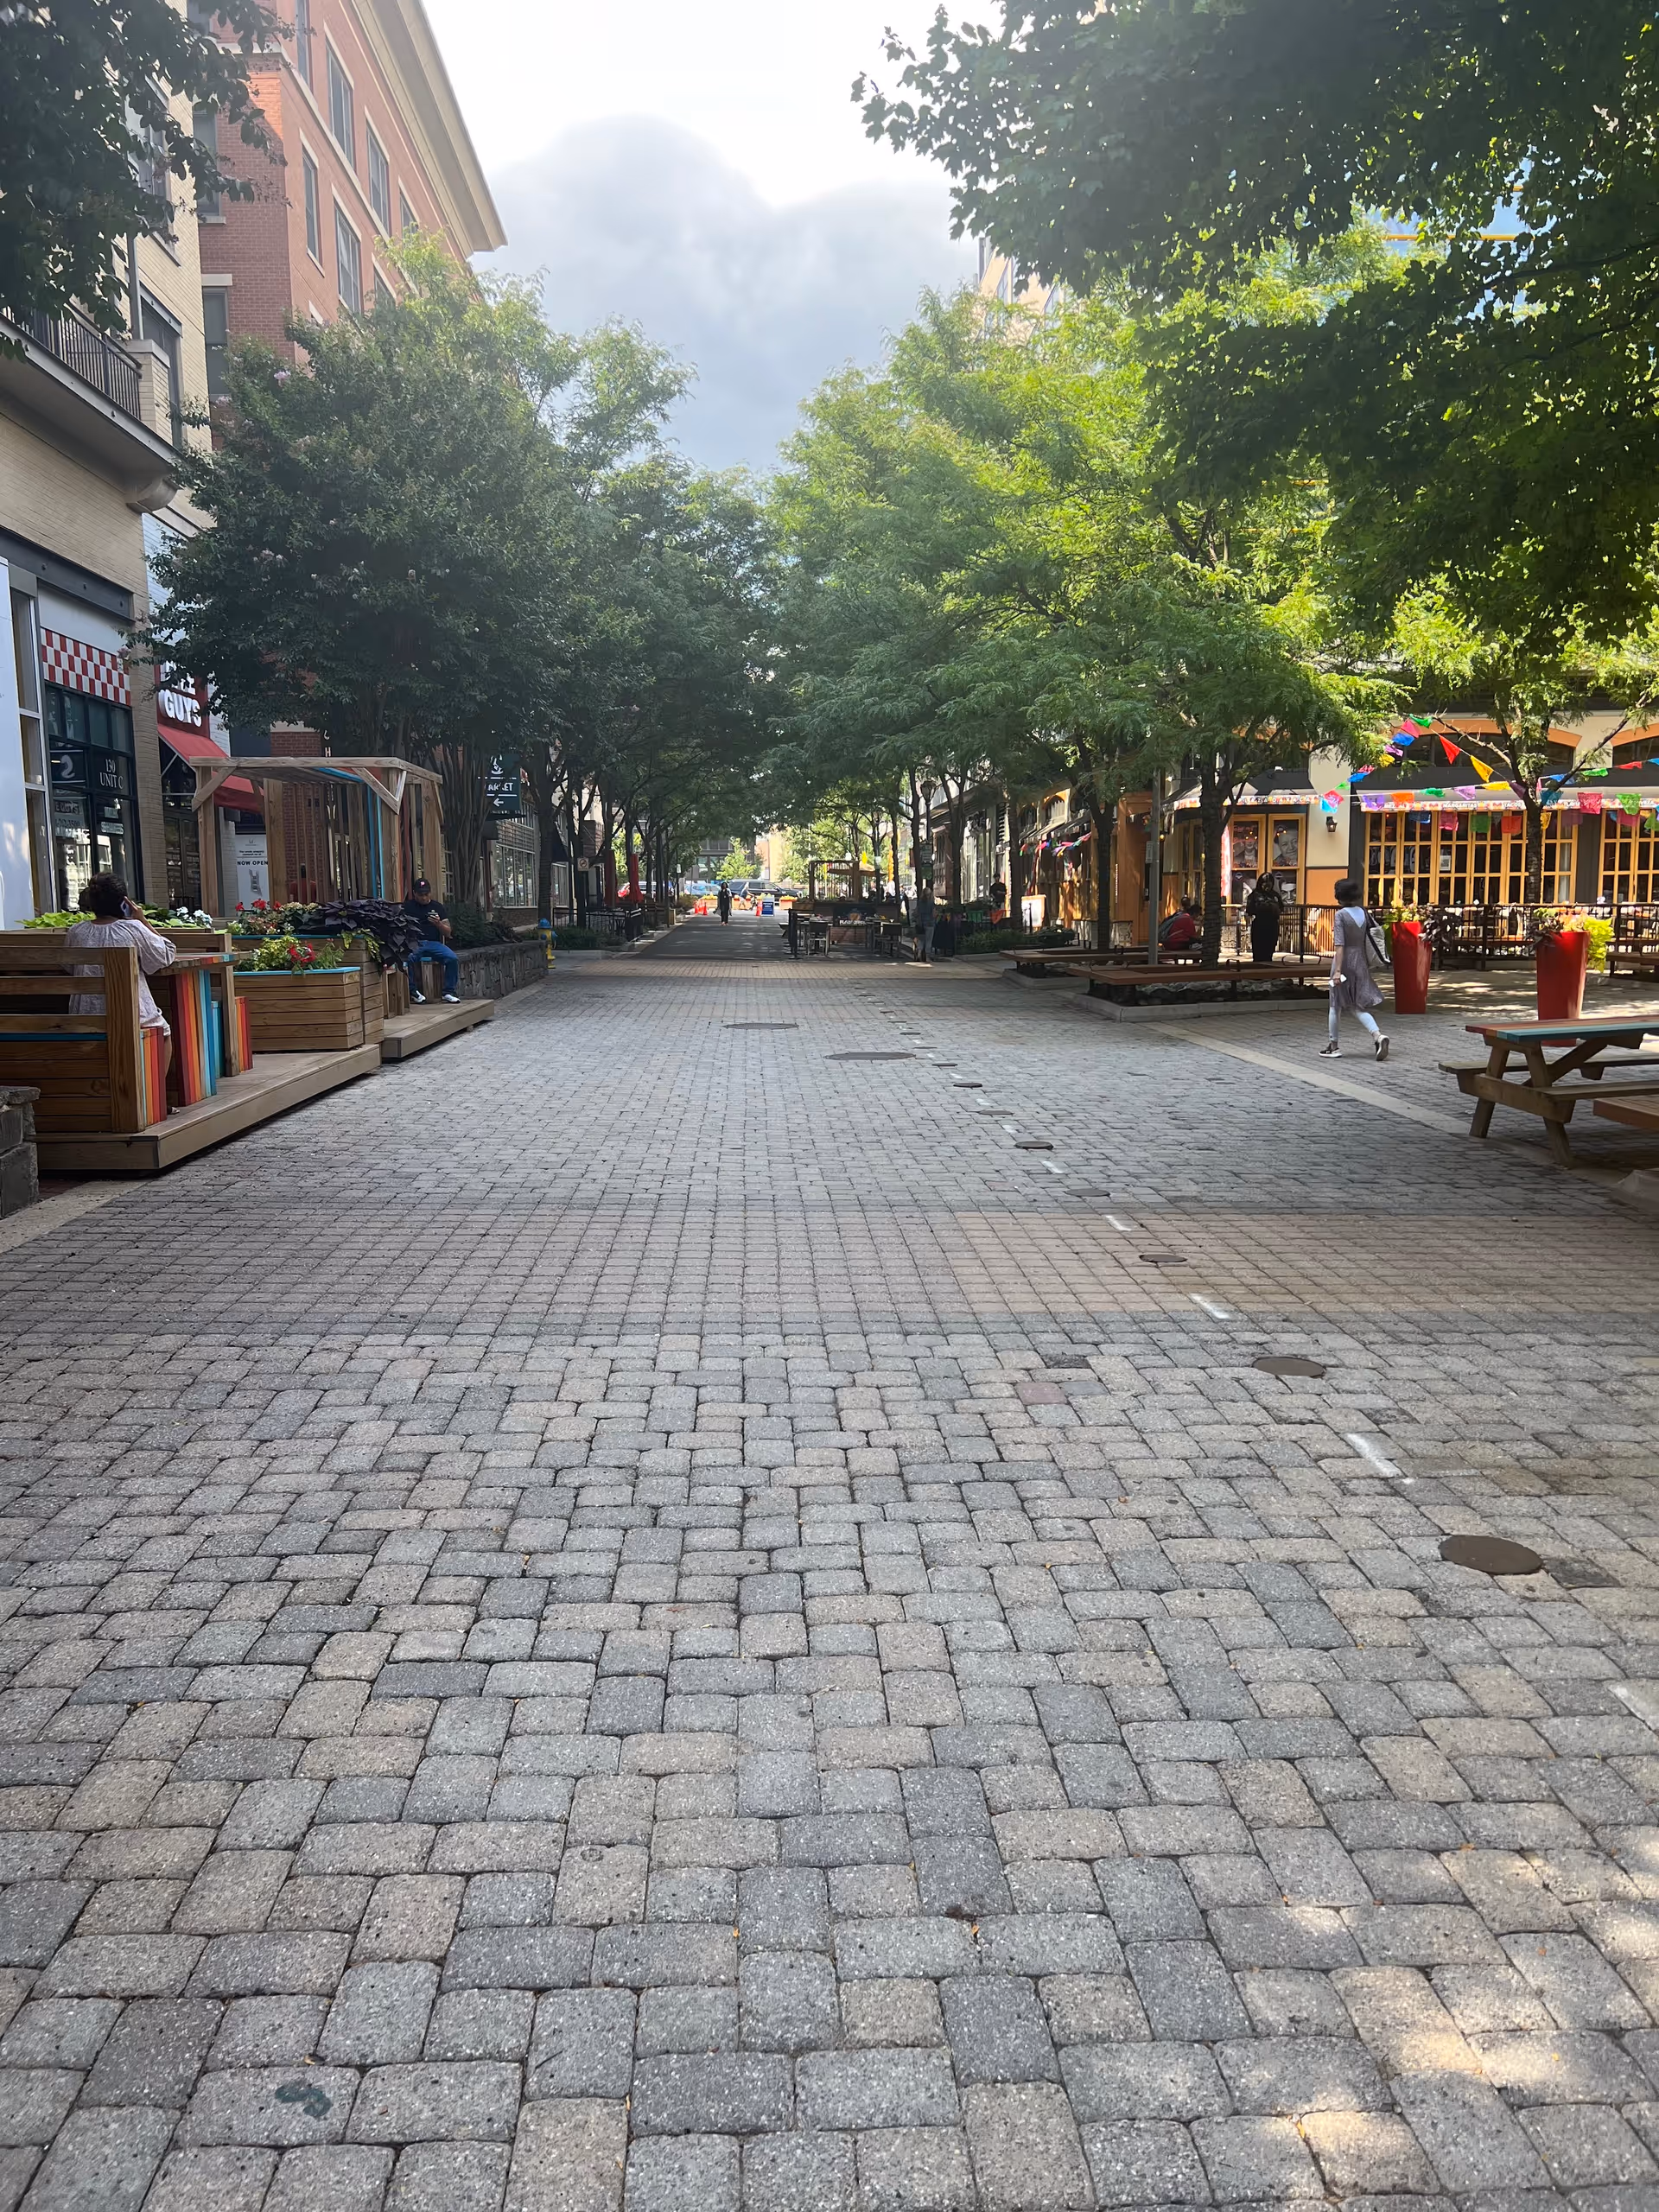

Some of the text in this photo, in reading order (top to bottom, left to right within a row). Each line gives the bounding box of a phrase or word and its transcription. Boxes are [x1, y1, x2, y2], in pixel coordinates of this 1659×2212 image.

[159, 689, 202, 728] GUYS
[105, 759, 116, 772] 130
[99, 772, 124, 790] UNIT C
